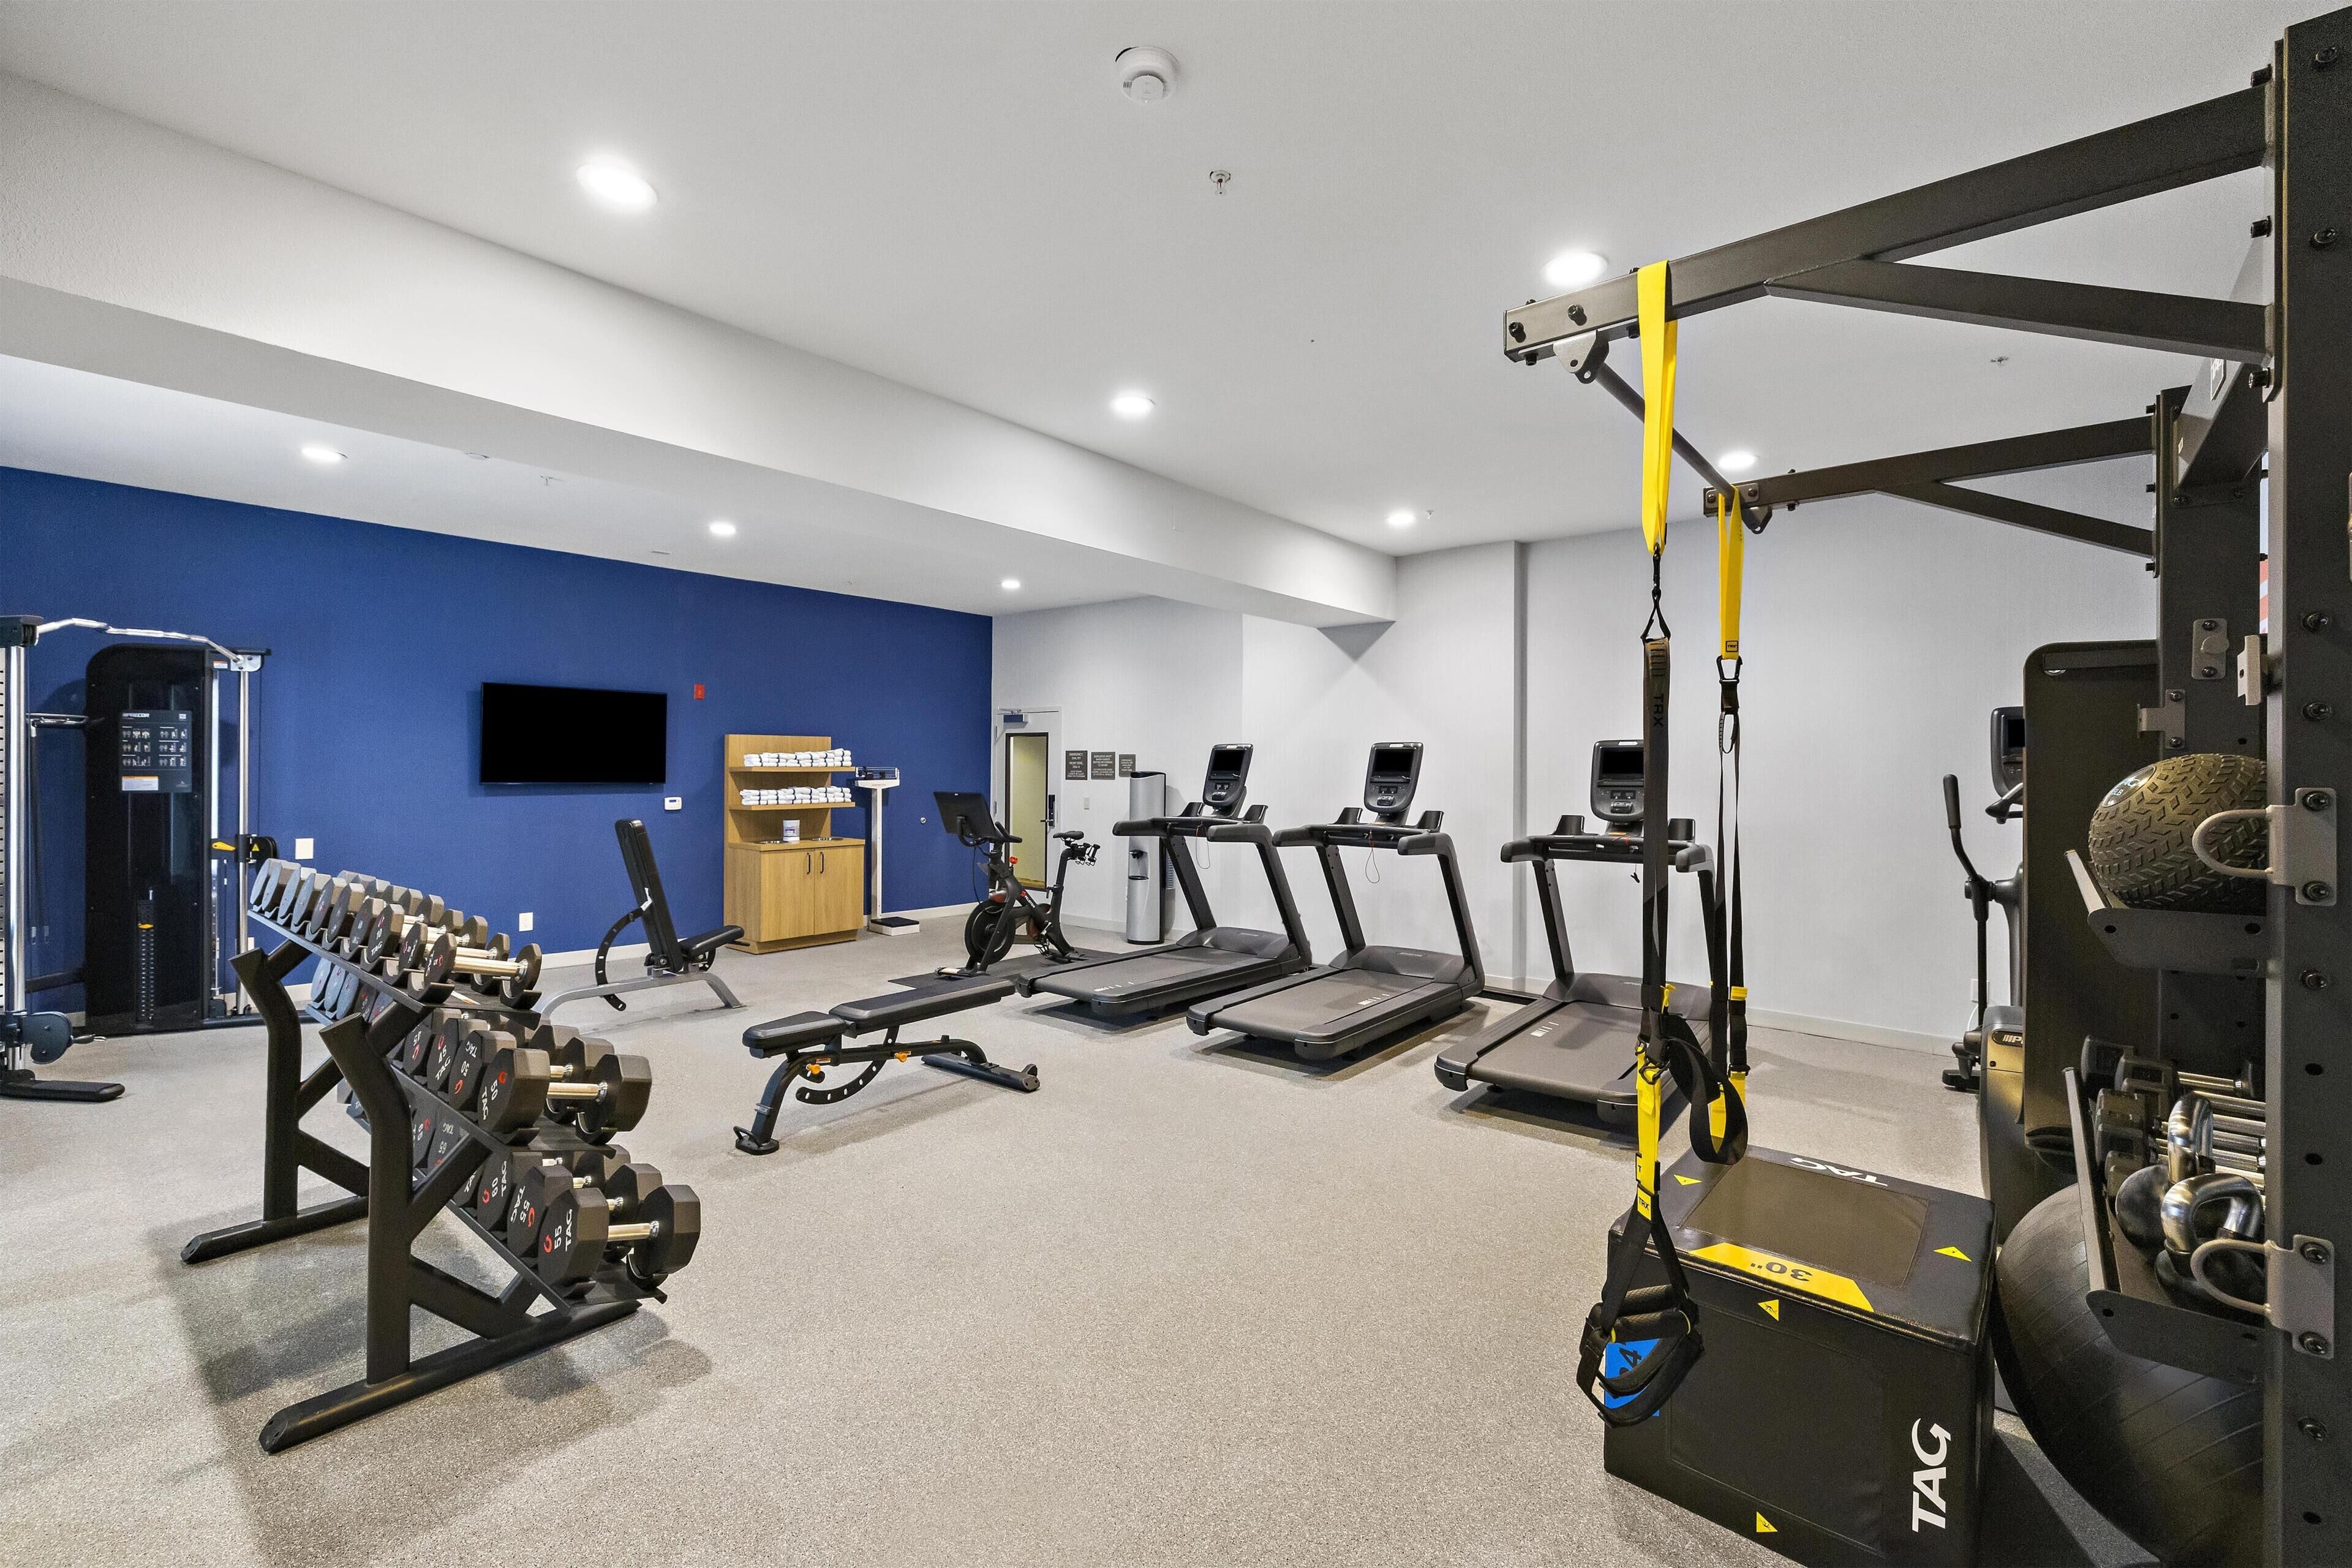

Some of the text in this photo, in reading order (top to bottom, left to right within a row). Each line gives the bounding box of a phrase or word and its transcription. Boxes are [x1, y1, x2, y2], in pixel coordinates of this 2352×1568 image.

[1653, 694, 1664, 727] TRX
[438, 1044, 447, 1064] 45
[465, 1040, 478, 1058] TAG
[435, 1056, 451, 1081] TAG
[461, 1060, 470, 1077] 50
[491, 1079, 499, 1101] 50
[442, 1122, 454, 1135] TAG
[464, 1170, 477, 1193] TA
[1789, 1157, 1888, 1187] TAG
[491, 1177, 499, 1197] 60
[510, 1185, 526, 1224] TAG
[520, 1199, 530, 1223] 55
[1638, 1196, 1650, 1211] TRX
[554, 1225, 562, 1250] 55
[565, 1208, 573, 1252] TAG
[1912, 1417, 1951, 1532] TAG
